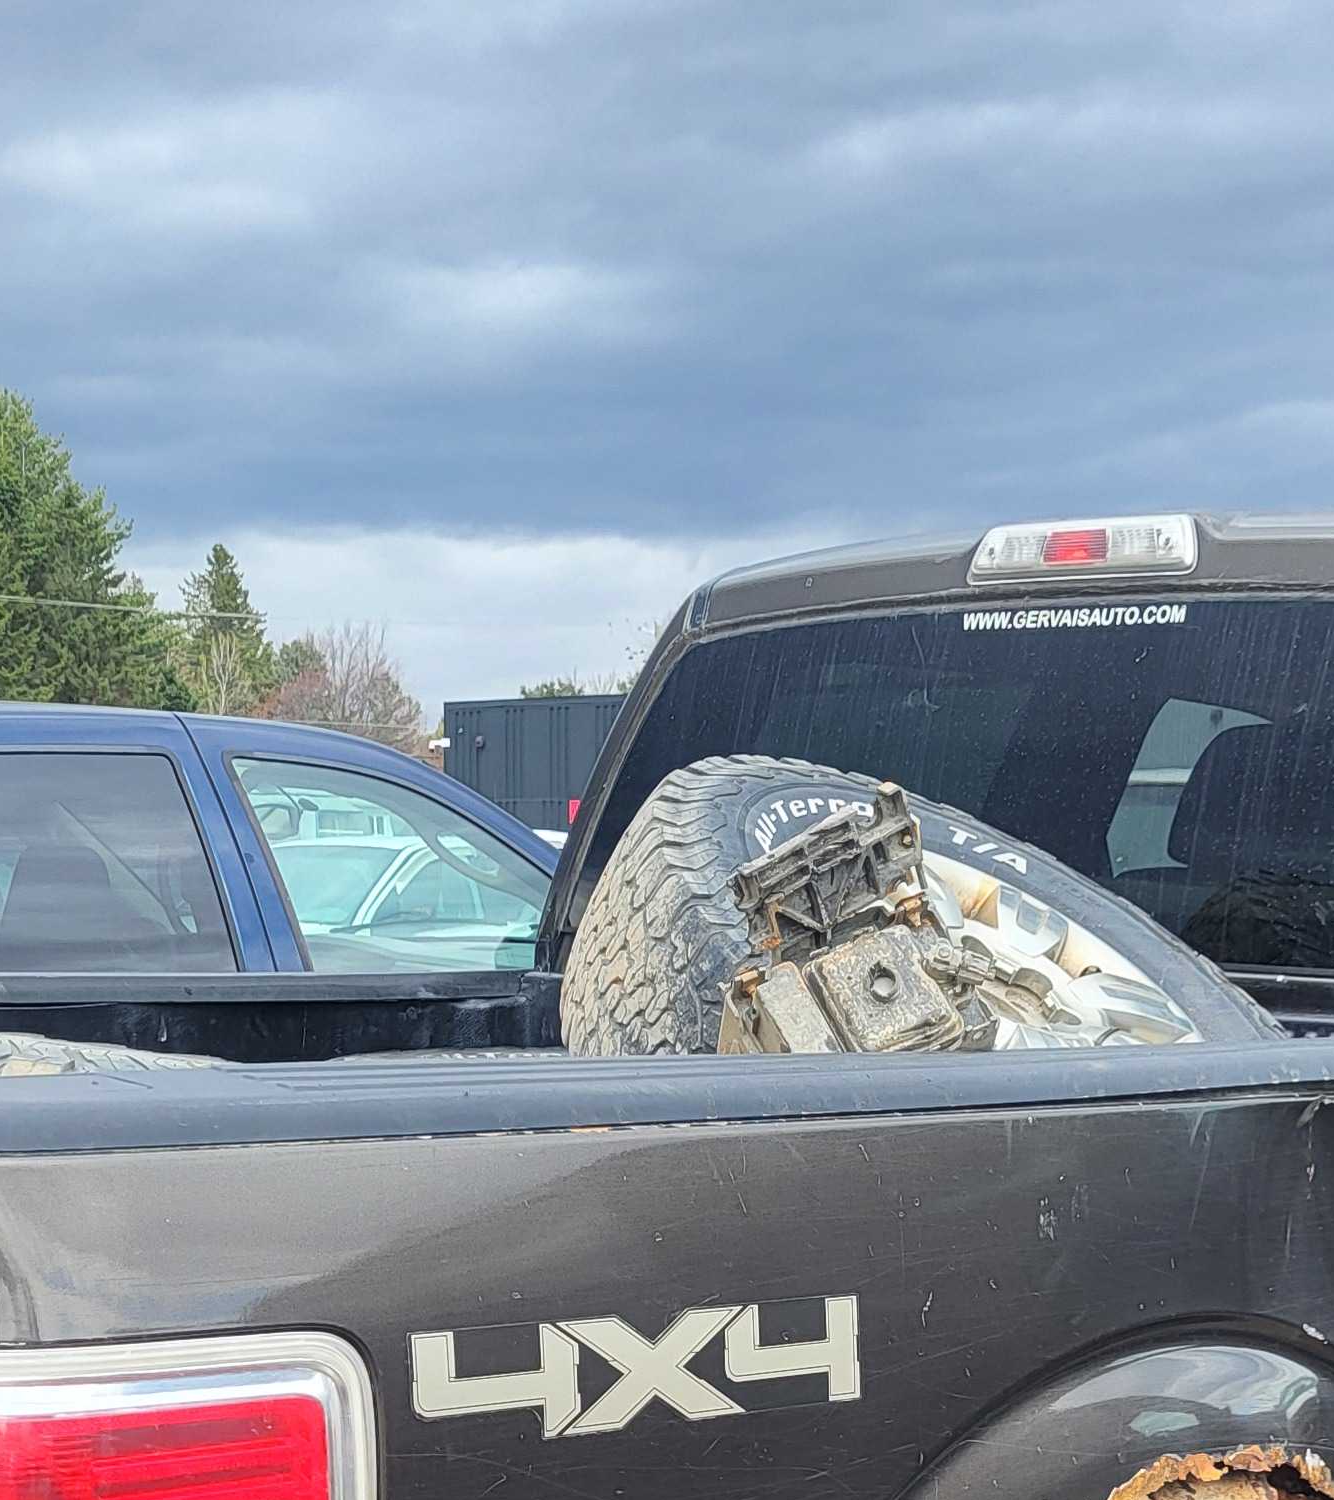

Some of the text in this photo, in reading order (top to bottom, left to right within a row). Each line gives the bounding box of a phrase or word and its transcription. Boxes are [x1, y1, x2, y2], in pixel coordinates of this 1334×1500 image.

[962, 604, 1188, 632] WWW.GERVAISAUTO.COM
[948, 826, 1028, 875] T/A
[410, 1294, 863, 1440] 4X4
